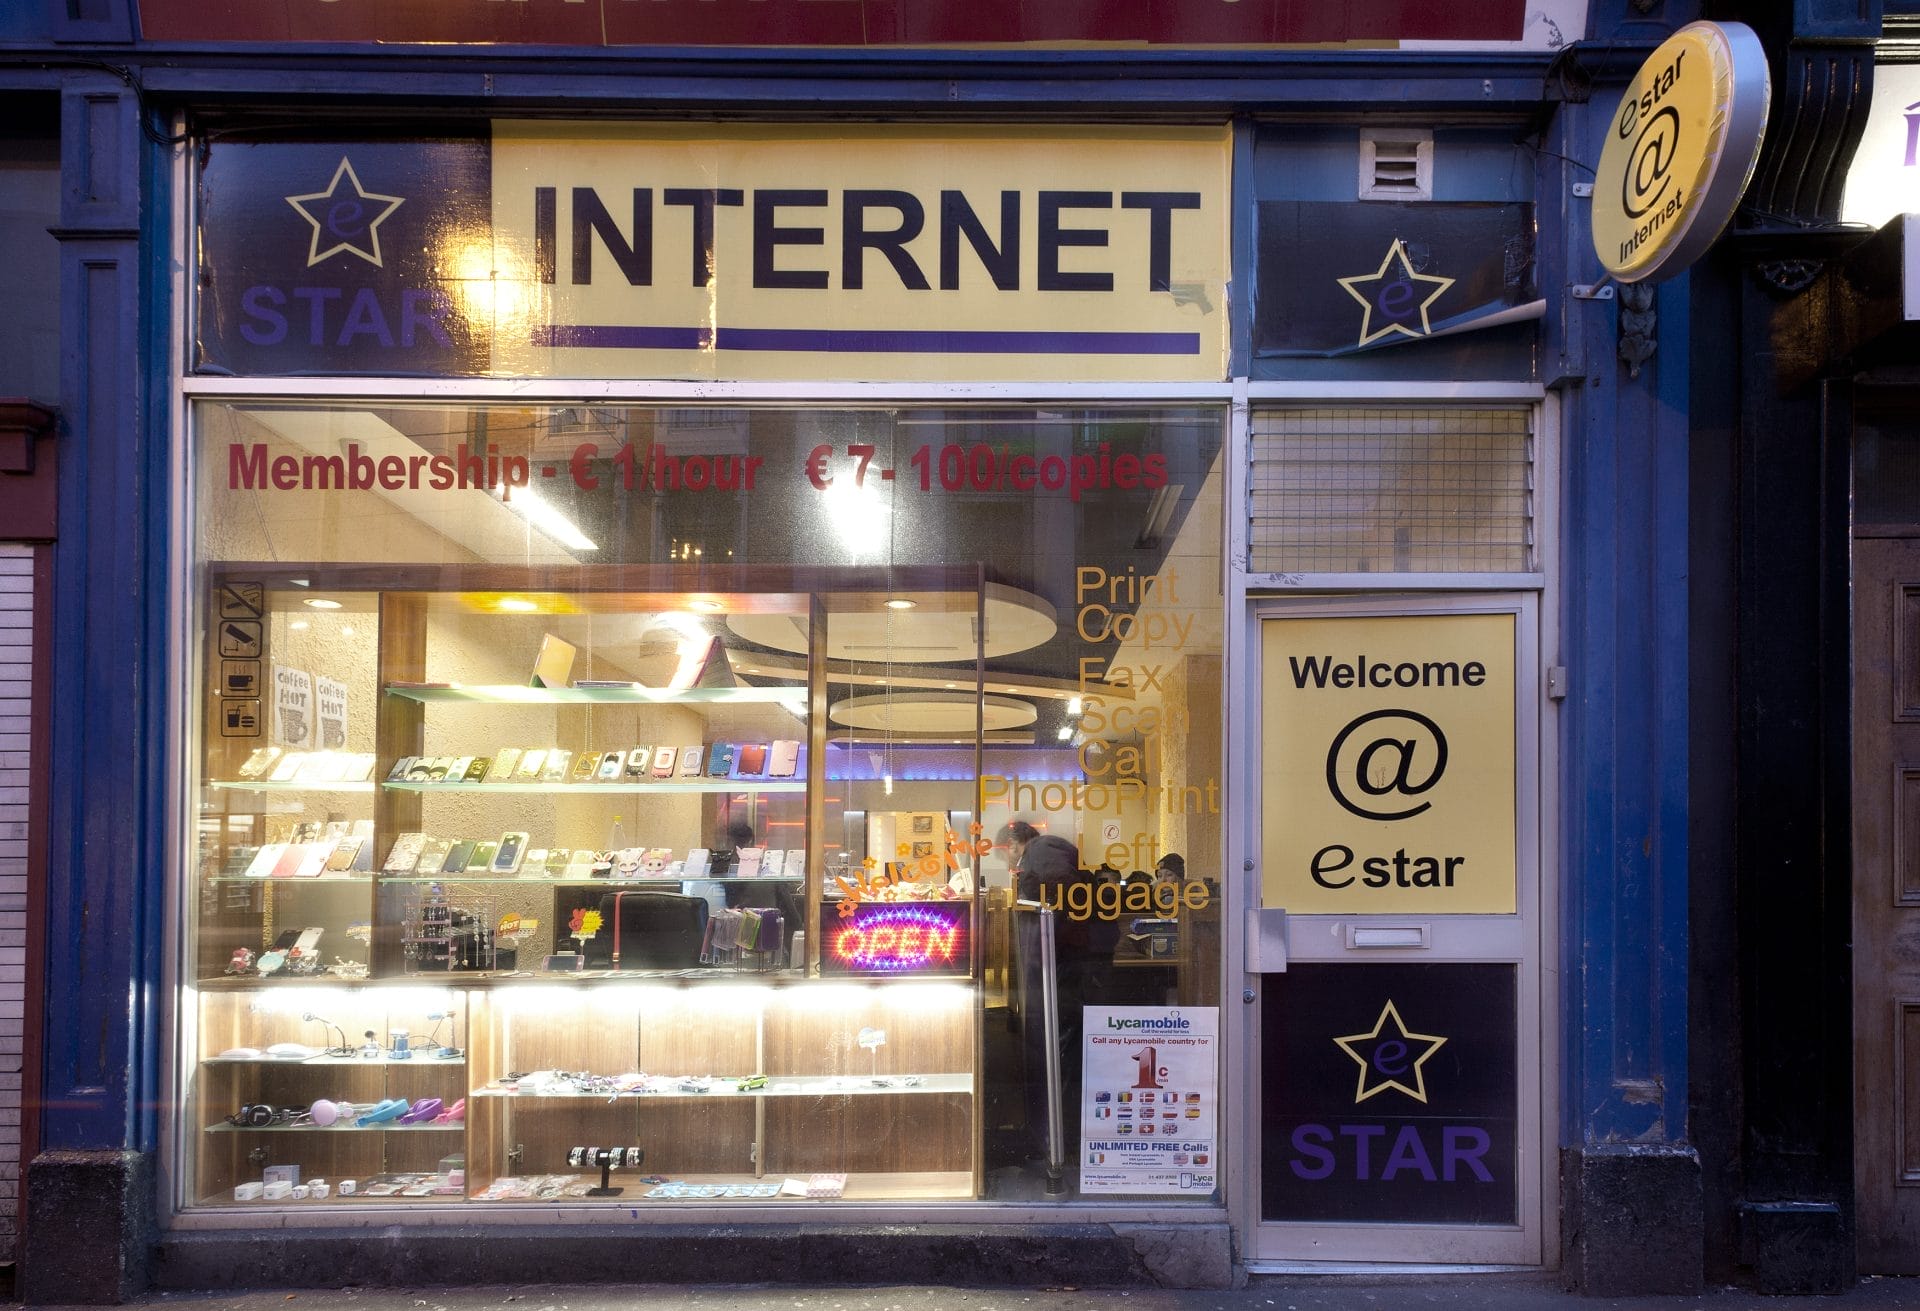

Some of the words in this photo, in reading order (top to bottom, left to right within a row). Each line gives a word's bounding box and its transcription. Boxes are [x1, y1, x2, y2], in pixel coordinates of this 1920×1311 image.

[328, 198, 363, 236] e
[1618, 187, 1684, 264] Internet
[536, 186, 1201, 292] INTERNET
[240, 286, 455, 349] STAR
[1377, 279, 1416, 320] e
[228, 443, 530, 502] Membership
[568, 443, 600, 491] €
[612, 443, 764, 492] 1/hour
[910, 443, 1169, 503] 100/copies
[1076, 566, 1181, 604] Print
[1076, 603, 1194, 652] Copy
[1078, 657, 1164, 694] Fax
[1289, 655, 1487, 690] Welcome
[280, 689, 306, 707] HOT
[322, 700, 343, 716] HOT
[1078, 696, 1191, 735] Scan
[1078, 739, 1163, 777] Call
[979, 775, 1221, 816] PhotoPrint
[835, 838, 993, 902] Welcome
[1078, 832, 1160, 871] Left
[1012, 876, 1210, 922] Luggage
[500, 919, 520, 931] HOT
[836, 926, 956, 960] OPEN
[1108, 1016, 1190, 1031] Lycamobile
[1108, 1038, 1122, 1046] any
[1123, 1037, 1166, 1046] Lycamobile
[1167, 1038, 1196, 1046] country
[1373, 1039, 1410, 1076] e
[1089, 1142, 1149, 1151] UNLIMITED
[1151, 1143, 1180, 1152] FREE
[1182, 1143, 1209, 1152] Calls
[1289, 1123, 1495, 1183] STAR
[1192, 1174, 1213, 1182] Lyca
